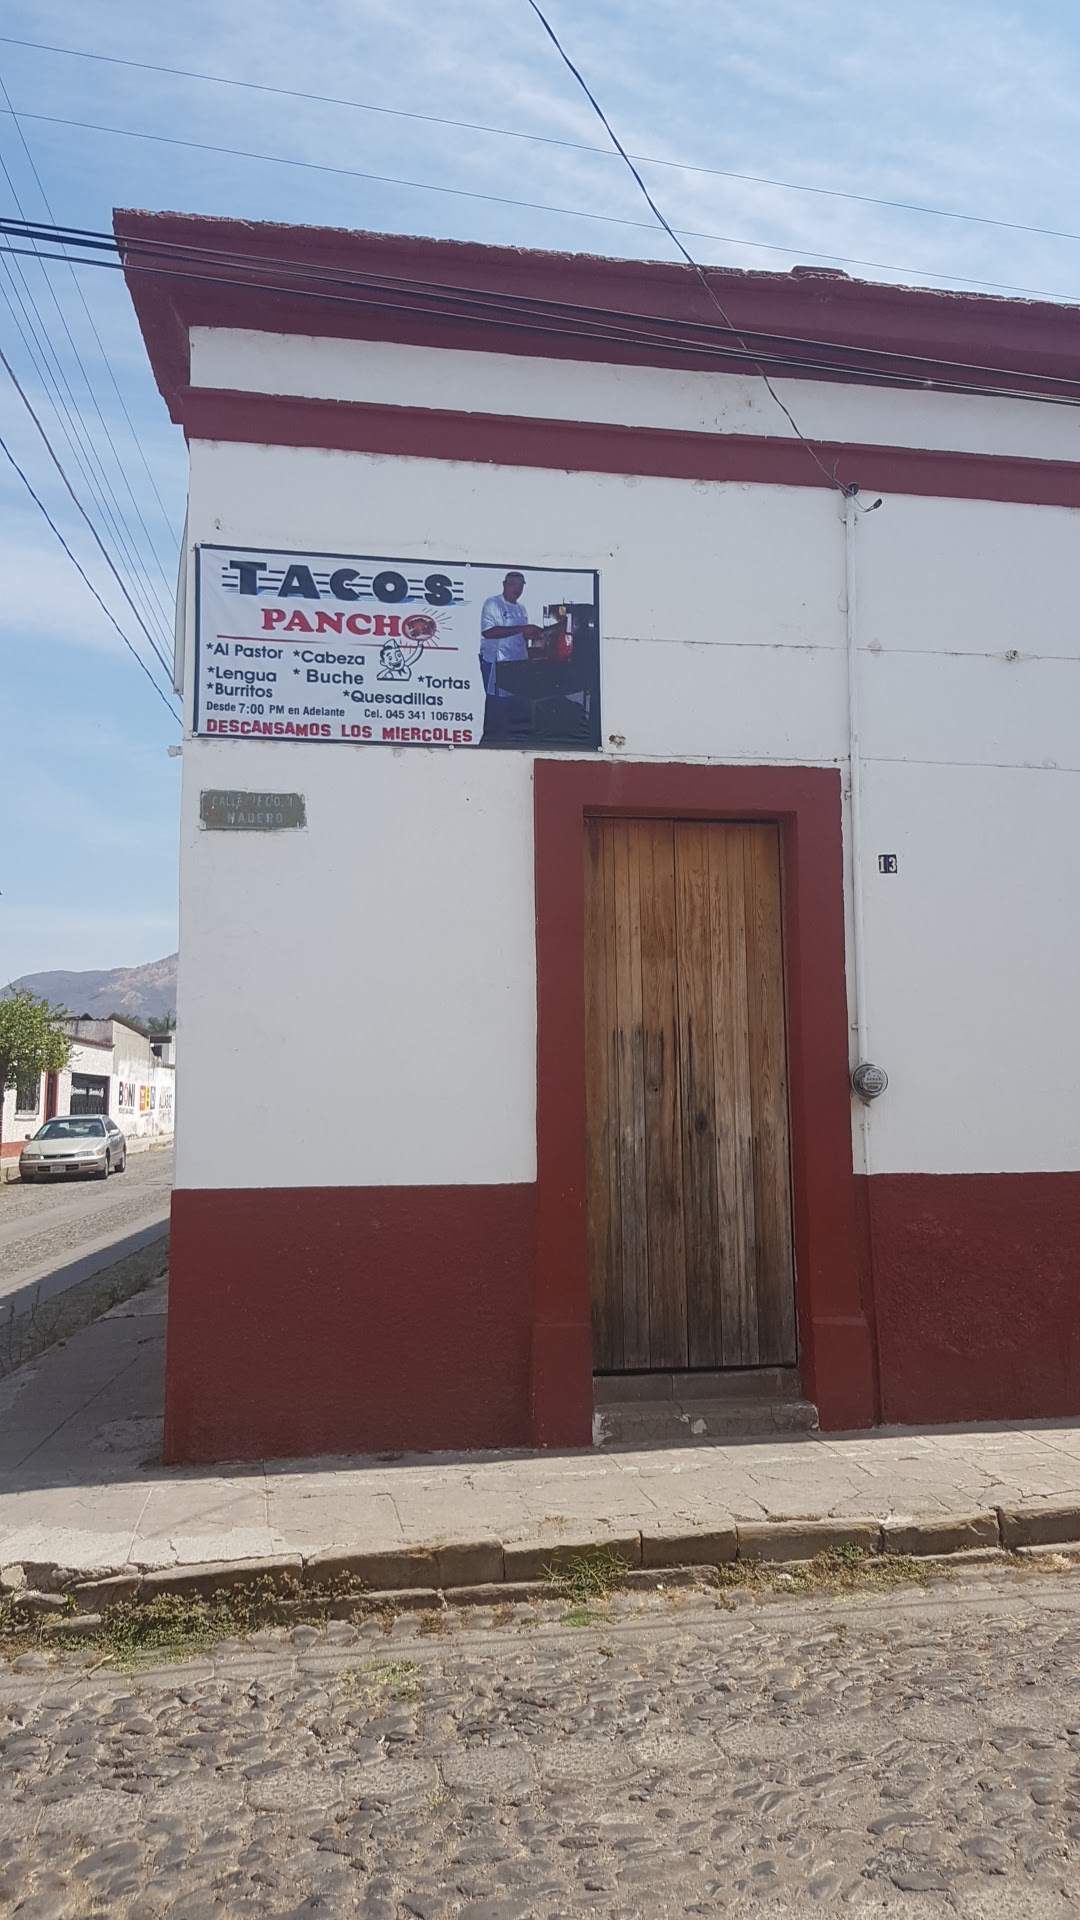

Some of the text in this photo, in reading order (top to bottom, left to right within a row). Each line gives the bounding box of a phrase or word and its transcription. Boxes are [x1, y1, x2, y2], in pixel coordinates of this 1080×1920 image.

[229, 560, 453, 606] TACOS
[261, 608, 437, 641] PANCHO
[213, 642, 283, 659] Al Pastor
[301, 650, 365, 665] Cabeza
[216, 666, 277, 684] Lengua
[306, 669, 364, 685] Buche
[425, 676, 470, 690] Tortas
[215, 682, 273, 698] Burritos
[351, 690, 444, 706] Quesadillas
[206, 701, 345, 717] Desde 7:00 PM en Adelante
[364, 709, 474, 722] Cel. 045 341 1067854
[206, 719, 473, 743] DESCANSAMOS LOS MIERCOLES
[227, 811, 283, 824] MADERO
[879, 856, 897, 872] 13
